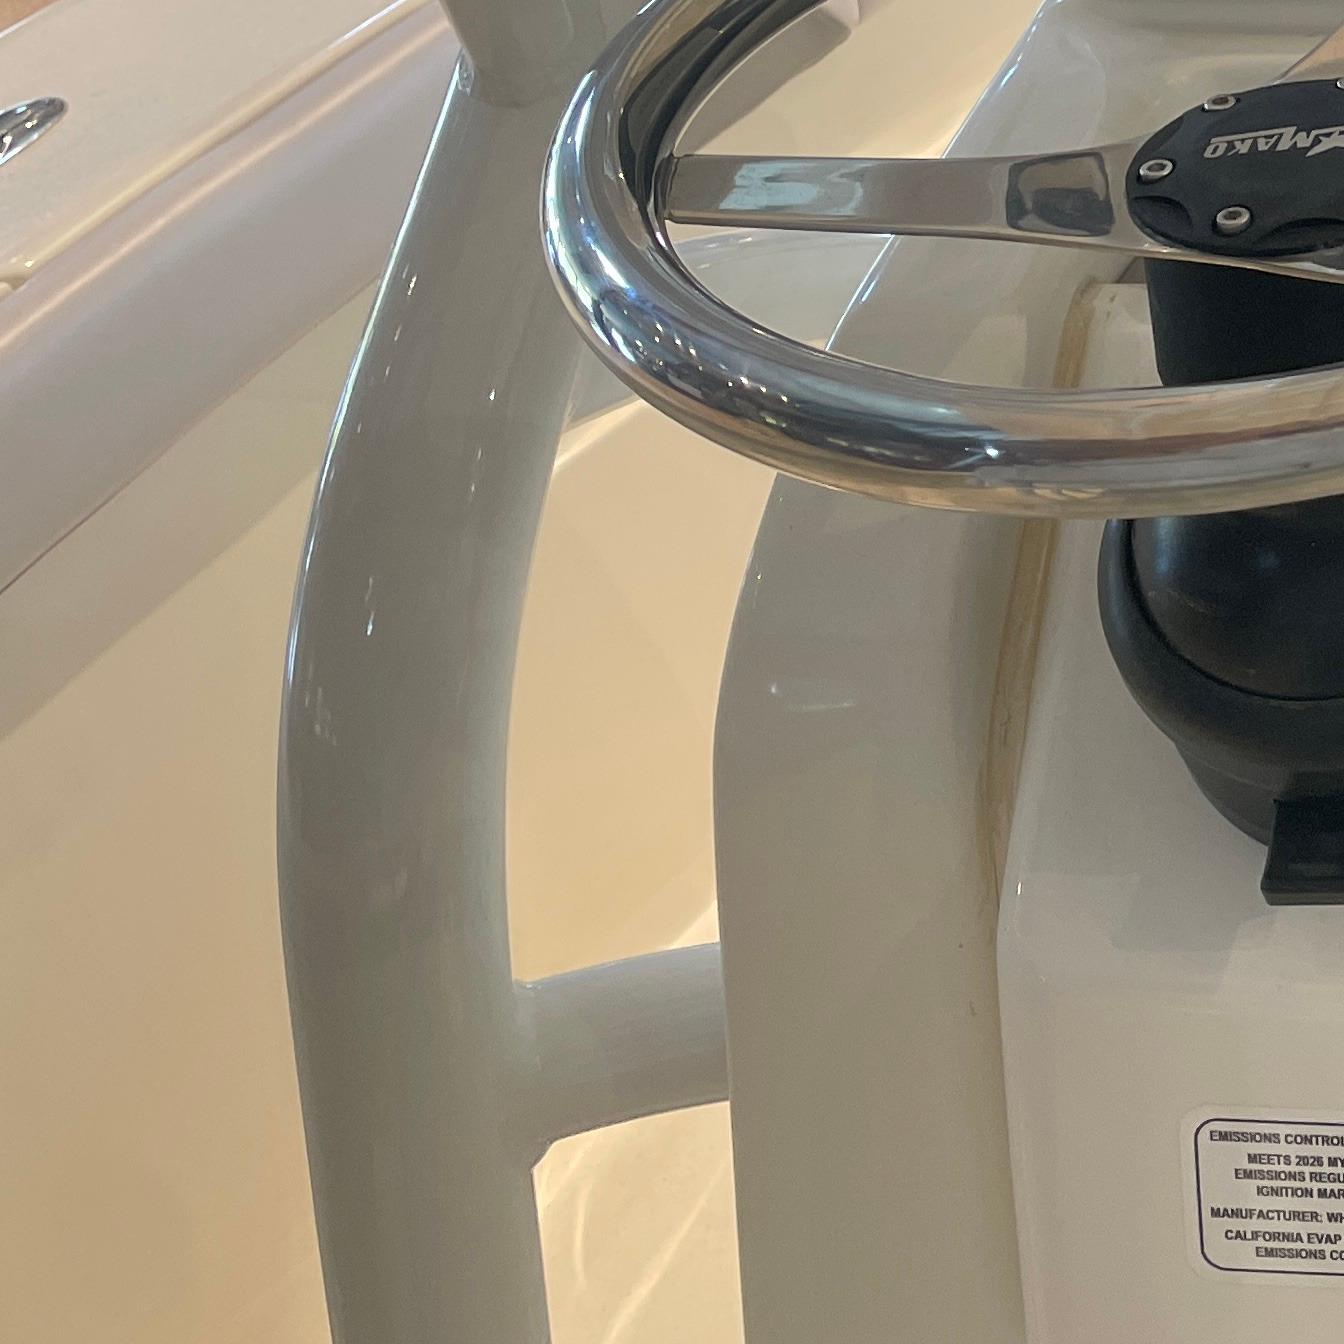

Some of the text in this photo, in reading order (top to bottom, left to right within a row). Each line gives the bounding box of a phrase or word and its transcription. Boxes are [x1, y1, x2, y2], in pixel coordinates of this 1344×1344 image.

[1209, 1130, 1281, 1145] EMISSIONS
[1247, 1153, 1292, 1166] MEETS
[1234, 1168, 1306, 1183] EMISSIONS
[1256, 1185, 1314, 1199] IGNITION
[1210, 1207, 1323, 1223] MANUFACTURER:
[1224, 1229, 1304, 1244] CALIFORNIA
[1307, 1232, 1342, 1245] EVAP
[1255, 1246, 1326, 1260] EMISSIONS
